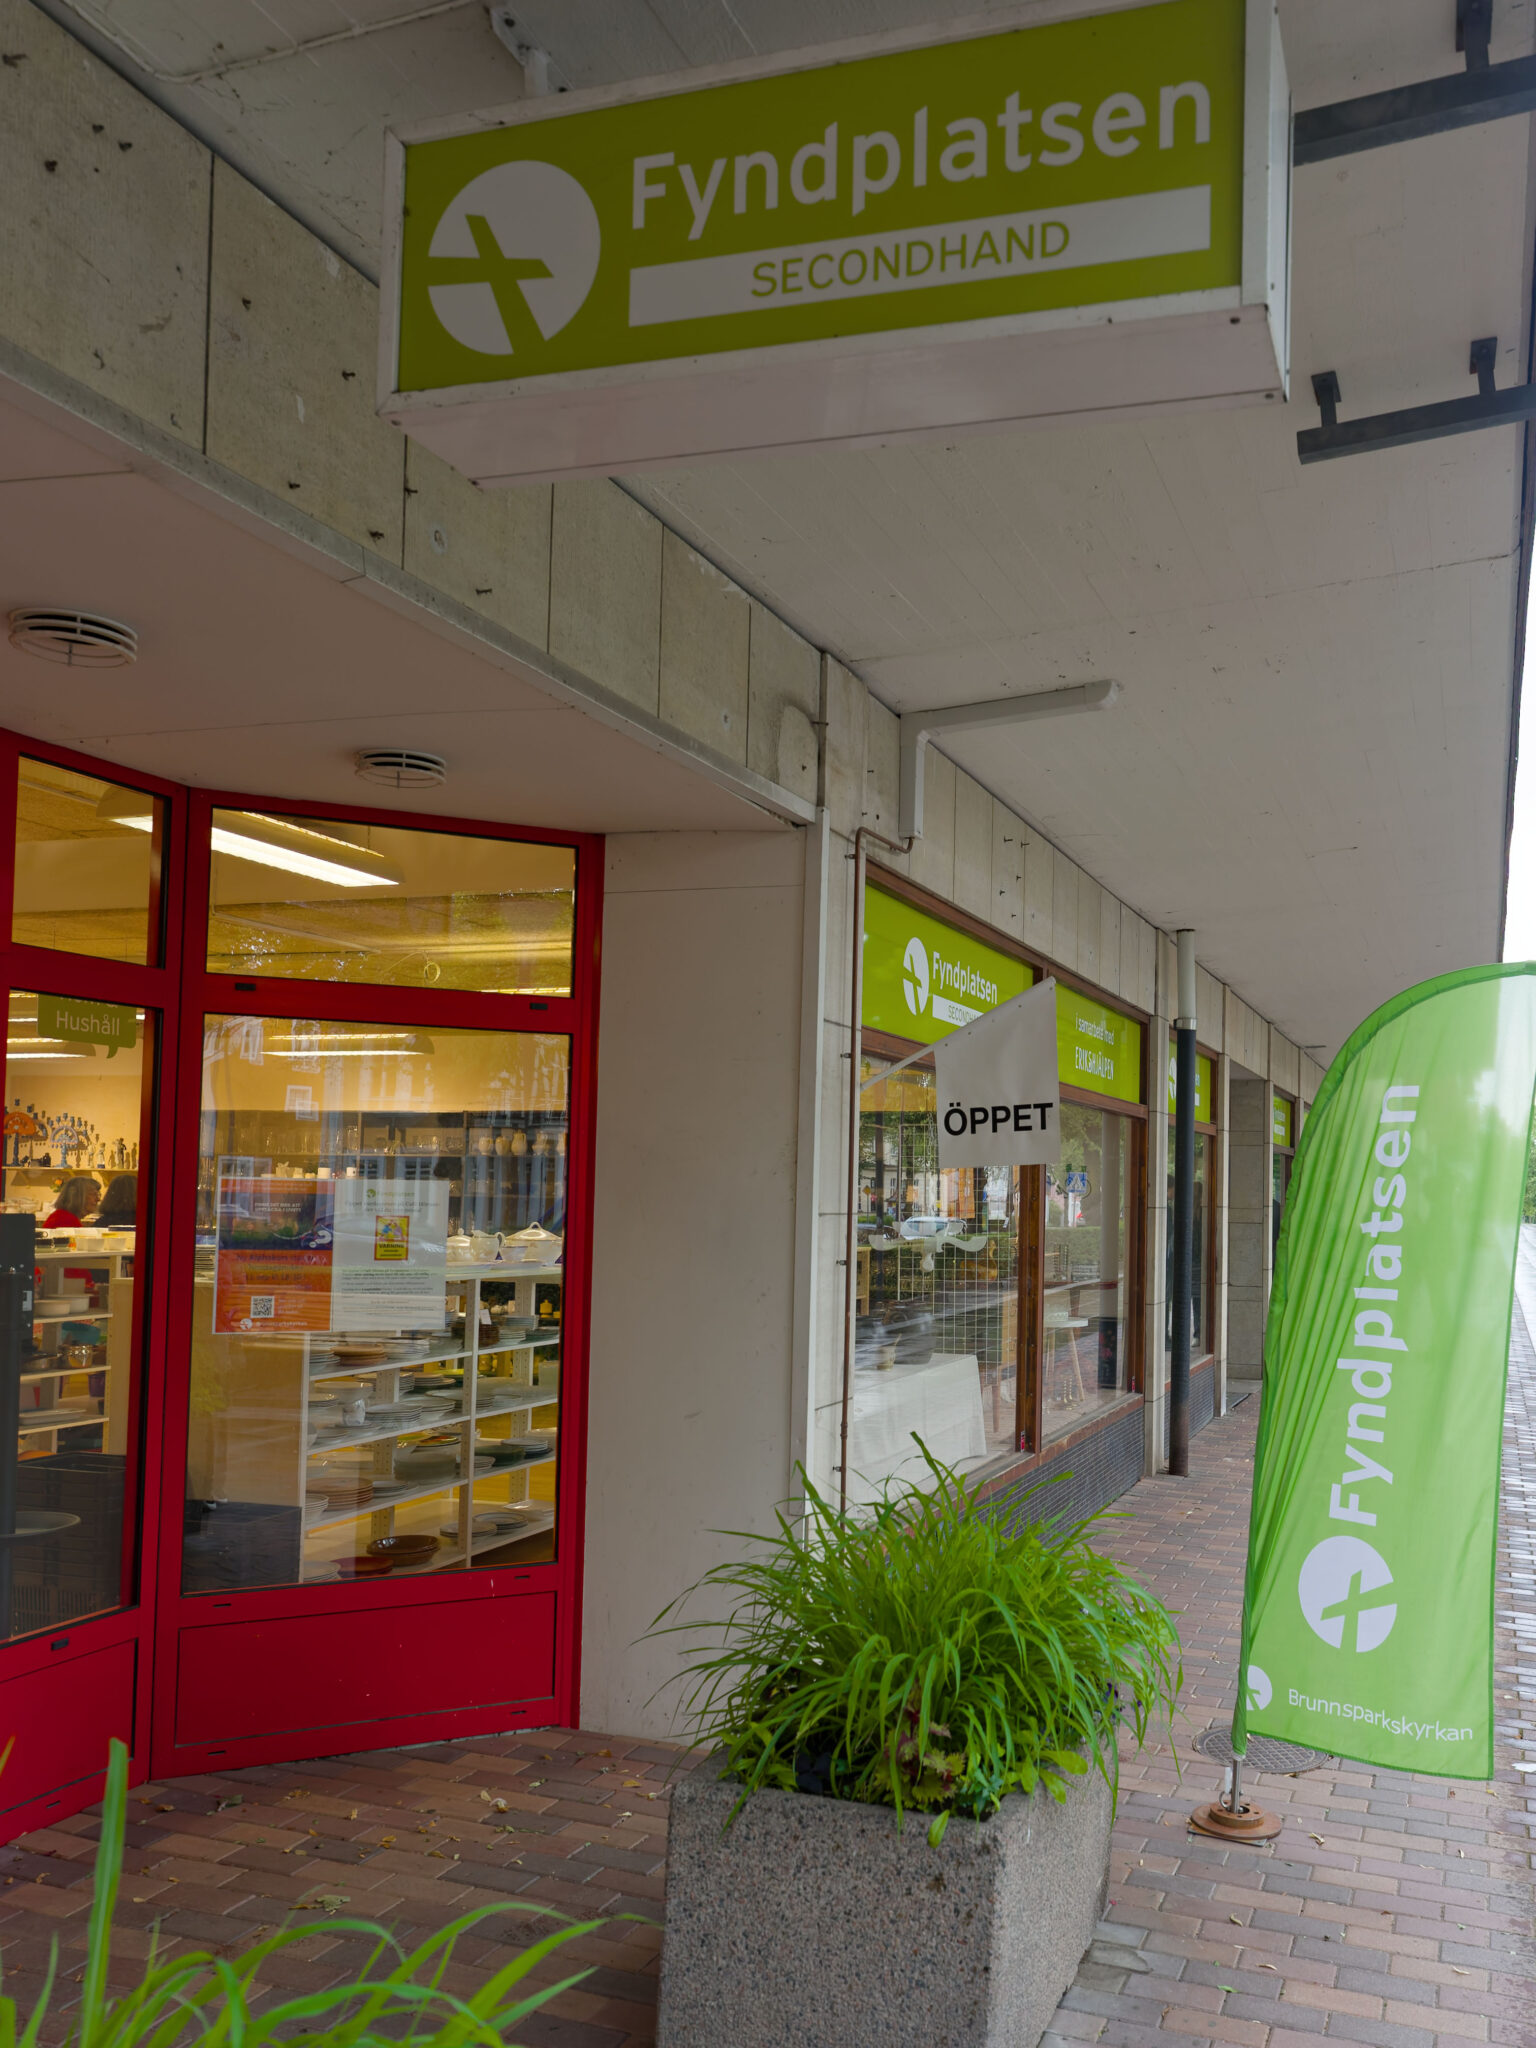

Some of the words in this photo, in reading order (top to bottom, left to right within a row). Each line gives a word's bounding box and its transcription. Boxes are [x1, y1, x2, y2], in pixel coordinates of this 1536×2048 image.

[632, 80, 1211, 241] Fyndplatsen
[751, 221, 1070, 297] SECONDHAND
[932, 950, 998, 1005] Fyndplatsen
[56, 1010, 120, 1036] Hushåll
[1079, 1018, 1104, 1041] samarbete
[1075, 1046, 1115, 1081] ERIKSHJÄLPEN
[944, 1102, 1054, 1136] ÖPPET
[1329, 1085, 1420, 1527] Fyndplatsen
[1288, 1689, 1474, 1741] Brunnsparkskyrkan
